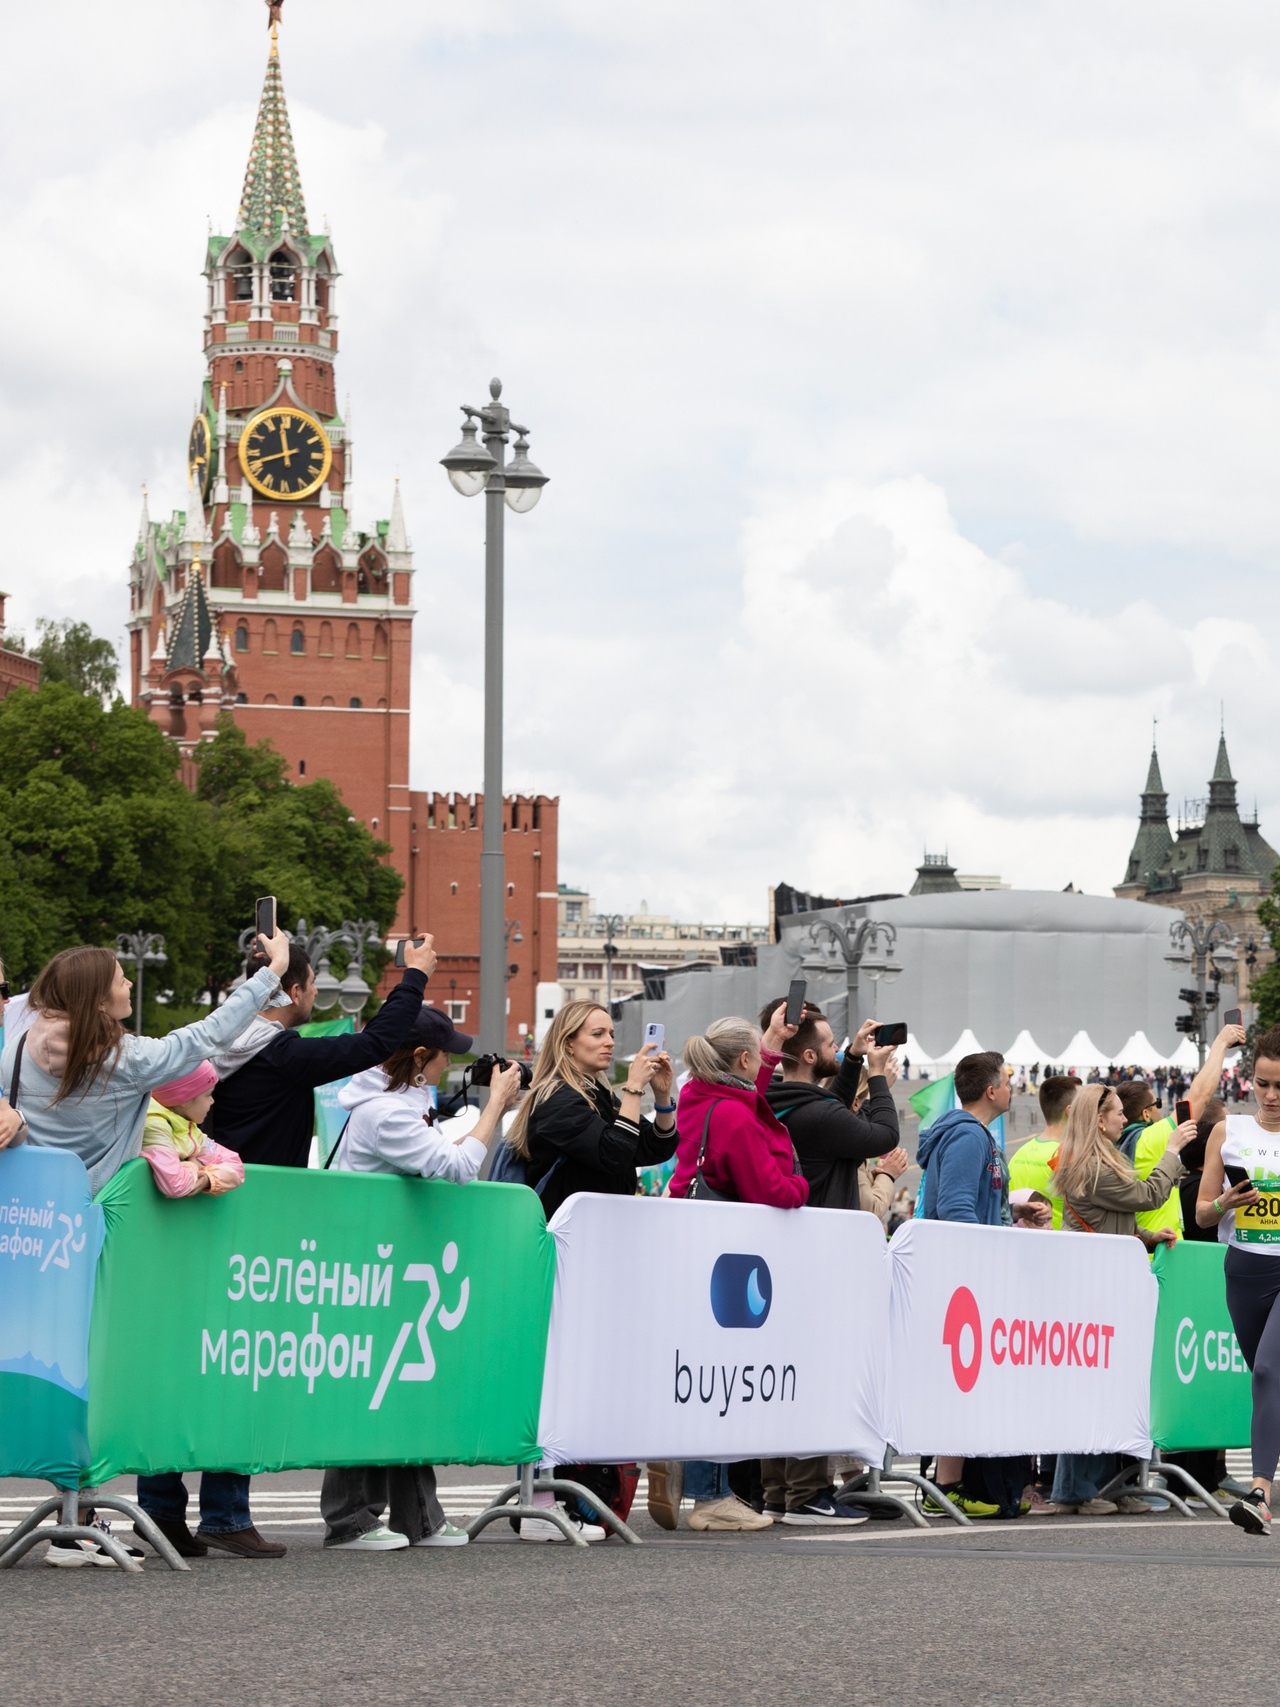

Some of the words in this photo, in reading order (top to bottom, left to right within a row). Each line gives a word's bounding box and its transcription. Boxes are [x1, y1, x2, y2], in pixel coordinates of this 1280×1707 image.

[1258, 1234, 1280, 1242] 4,2км
[227, 1239, 393, 1307] зелёный
[201, 1312, 373, 1394] марафон
[990, 1317, 1115, 1369] самокат
[1203, 1329, 1248, 1373] СБЕ
[674, 1349, 797, 1417] buyson
